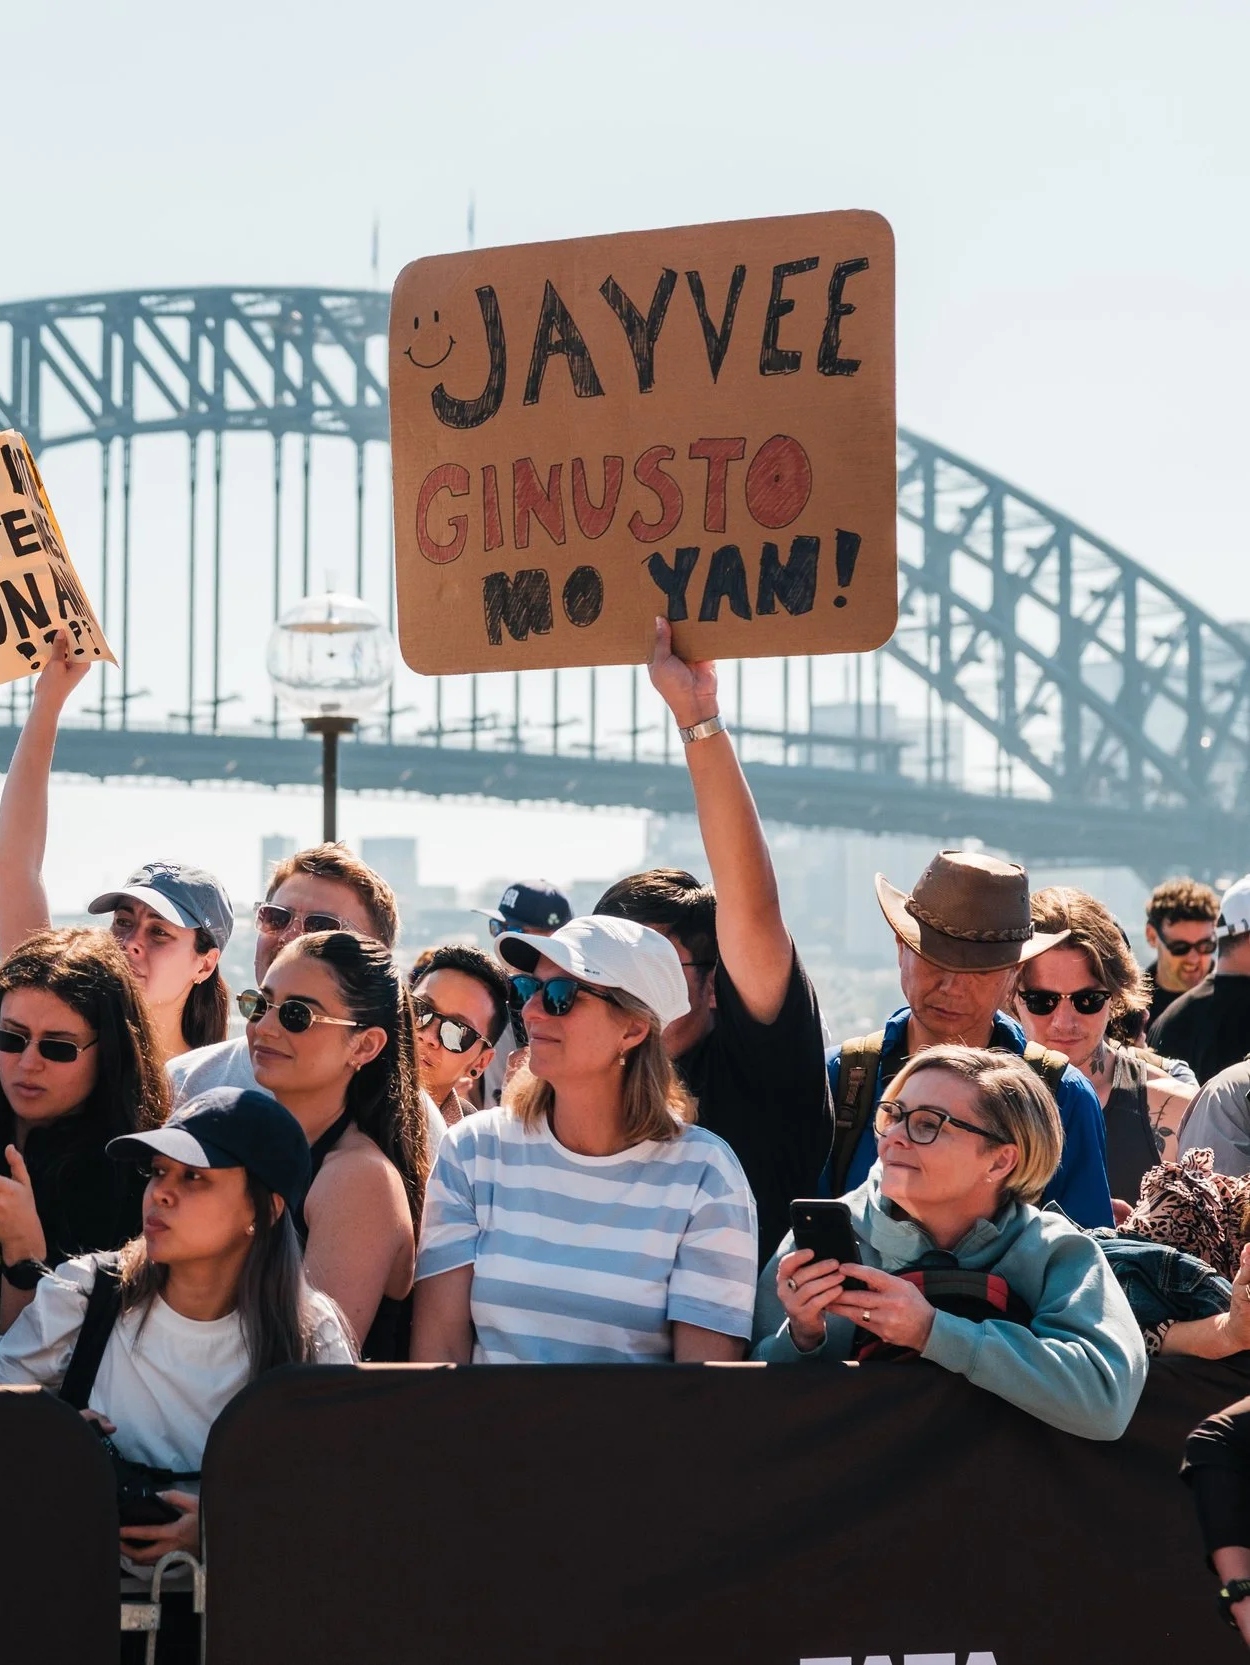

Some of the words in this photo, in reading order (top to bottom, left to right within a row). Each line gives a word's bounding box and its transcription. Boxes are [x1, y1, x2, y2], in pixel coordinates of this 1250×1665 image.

[431, 257, 869, 429] JAYVEE
[416, 434, 812, 564] GINUSTO
[642, 529, 861, 622] YAN!
